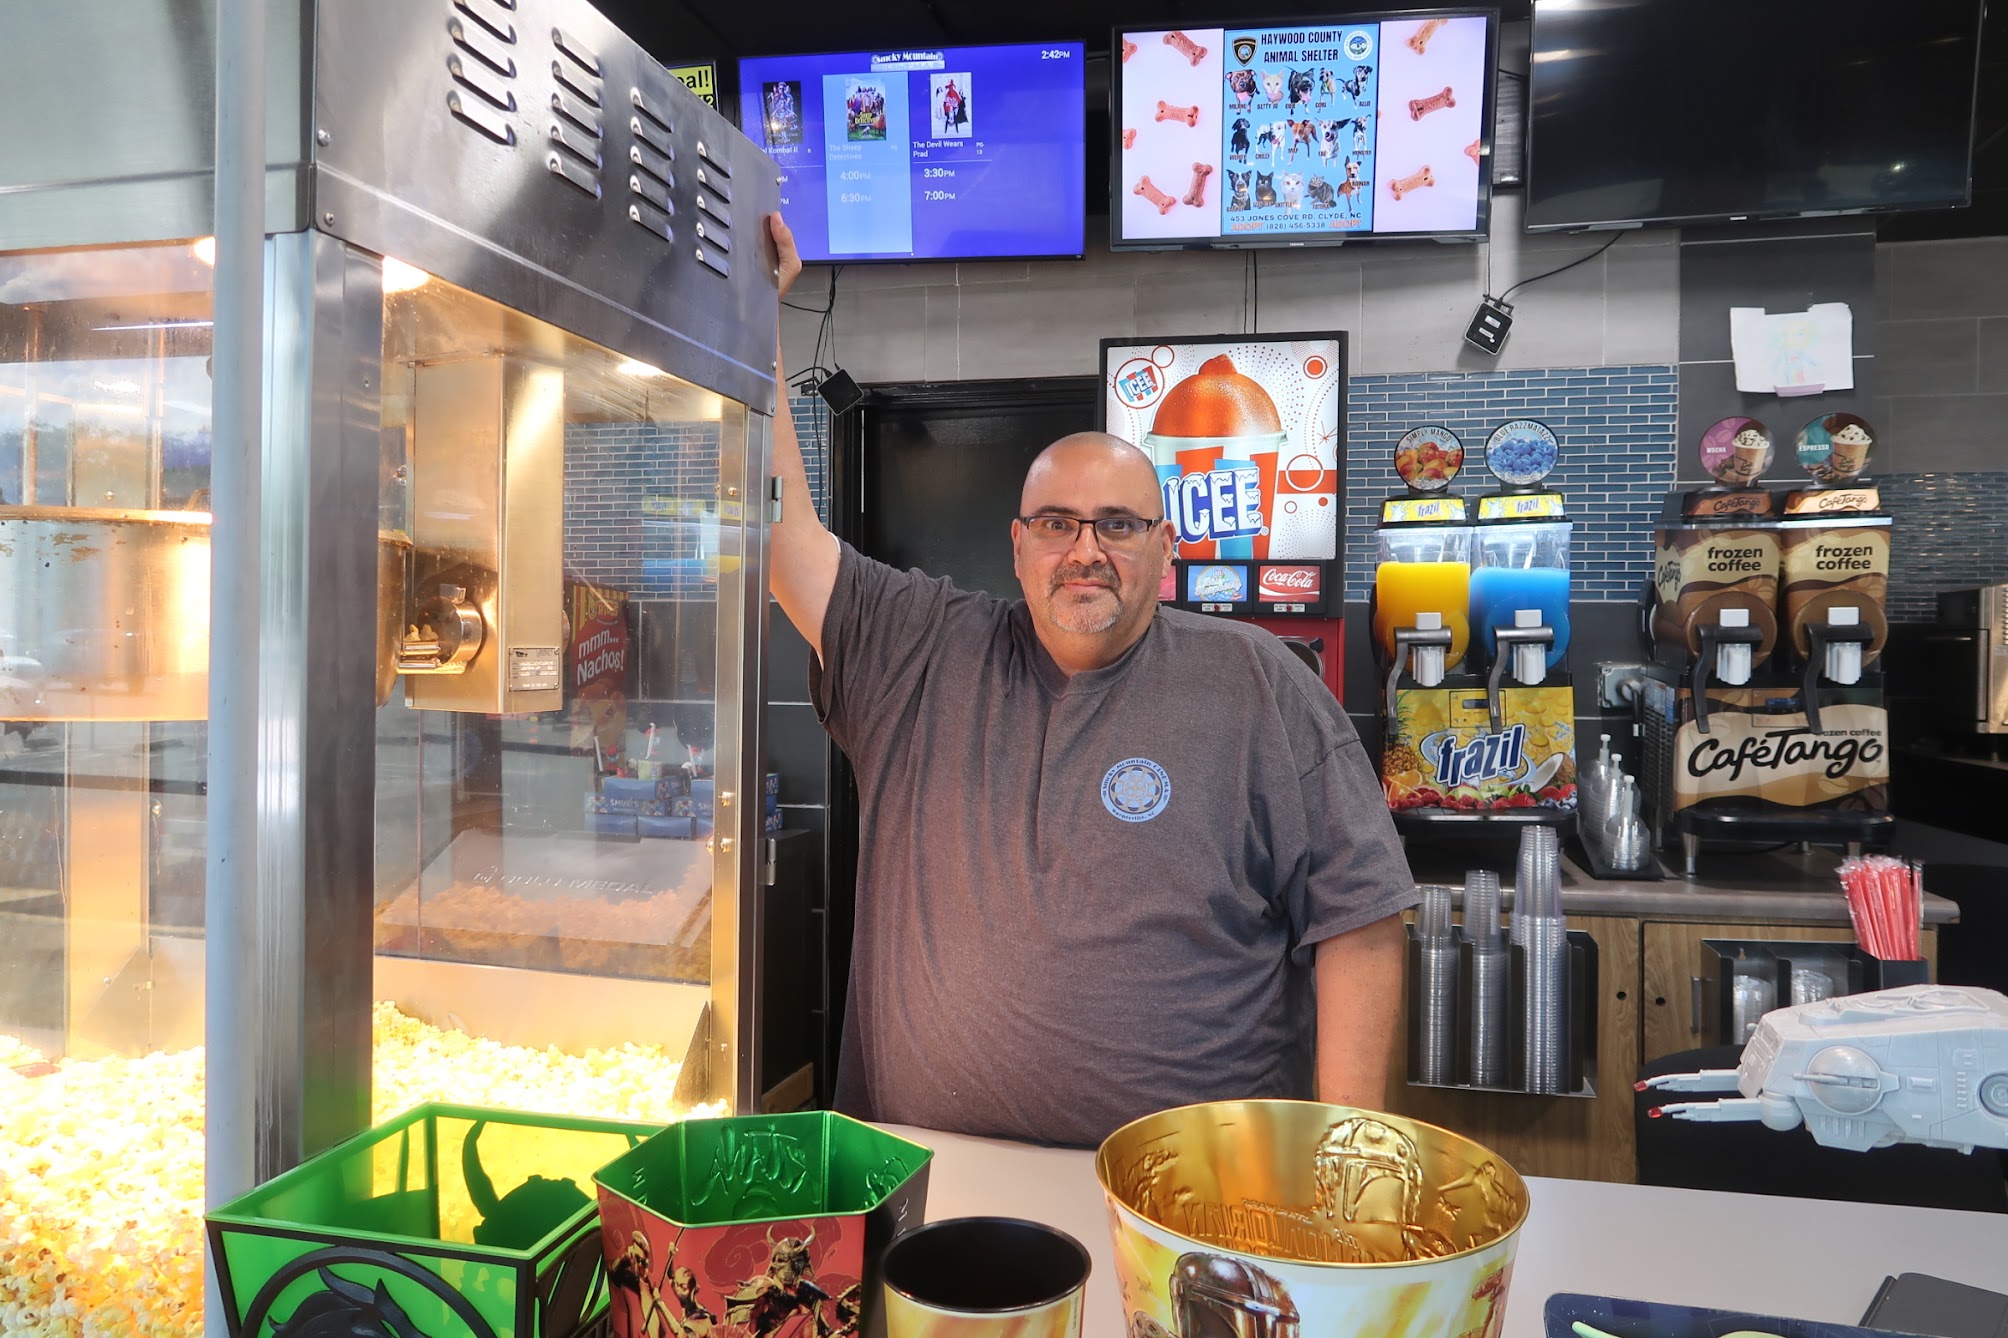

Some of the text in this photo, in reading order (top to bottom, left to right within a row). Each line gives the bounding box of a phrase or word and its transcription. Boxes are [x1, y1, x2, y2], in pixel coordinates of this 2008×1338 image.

[1261, 31, 1343, 45] HAYWOOD COUNTY
[1041, 50, 1070, 60] 2:42PM
[1264, 49, 1338, 63] ANIMAL SHELTER
[677, 68, 710, 89] al!
[943, 140, 964, 148] Wears
[913, 150, 928, 158] Prad
[840, 171, 871, 180] 4:00PM
[924, 168, 955, 178] 3:30PM
[841, 193, 871, 202] 6:30PM
[924, 190, 956, 200] 7:00PM
[1231, 222, 1264, 231] ADOPT
[1329, 220, 1362, 229] ADOPT
[1125, 371, 1154, 399] ICEE
[1406, 428, 1452, 442] SIMPLY MANGO
[1493, 427, 1510, 442] BLUE
[1163, 468, 1262, 542] ICEE
[1418, 502, 1440, 517] frazil
[1517, 497, 1538, 514] frazil
[1708, 547, 1763, 558] frozen
[1816, 545, 1872, 558] frozen
[1708, 558, 1761, 572] coffee
[1816, 557, 1871, 570] coffee
[1262, 568, 1317, 588] Coca-Cola
[578, 629, 618, 659] mmm...
[577, 649, 624, 686] Nachos!
[1437, 724, 1526, 787] frazil
[1688, 728, 1884, 782] CaféTango
[1116, 759, 1152, 770] Mountain
